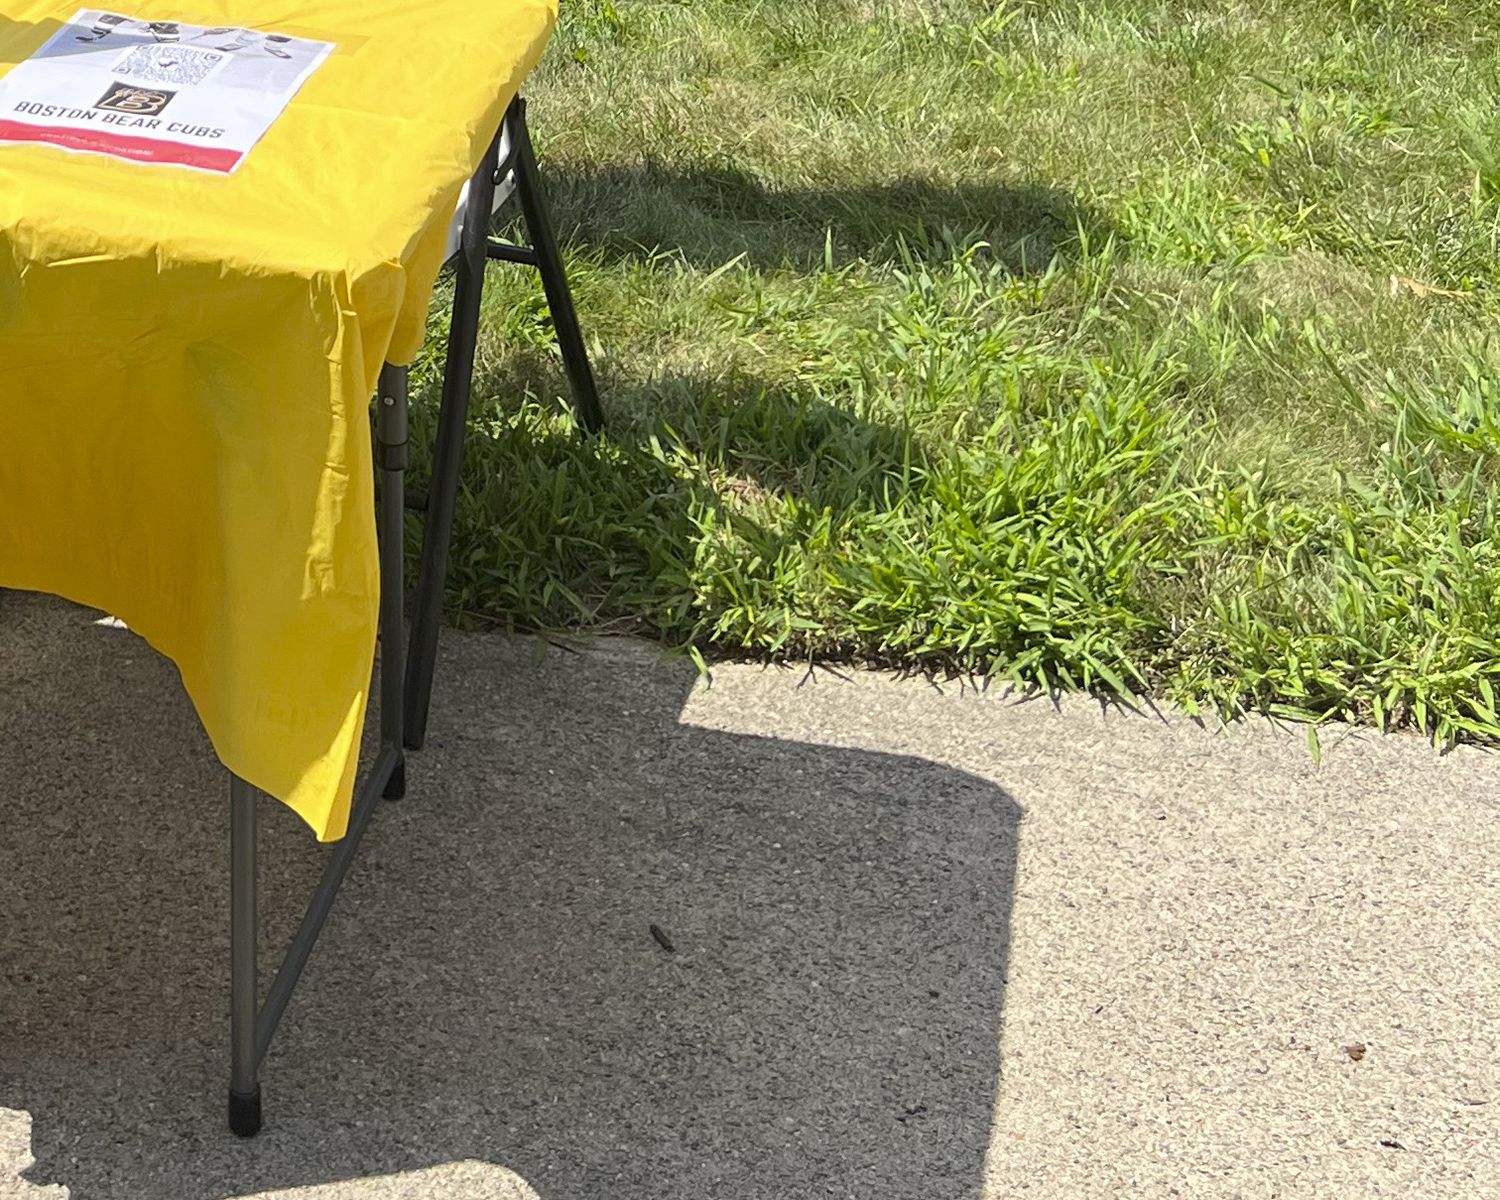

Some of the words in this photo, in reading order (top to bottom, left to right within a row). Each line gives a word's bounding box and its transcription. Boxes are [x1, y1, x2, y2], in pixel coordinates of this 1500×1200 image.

[13, 100, 98, 121] BOSTON
[102, 112, 163, 130] BEAR
[166, 121, 226, 139] CUBS
